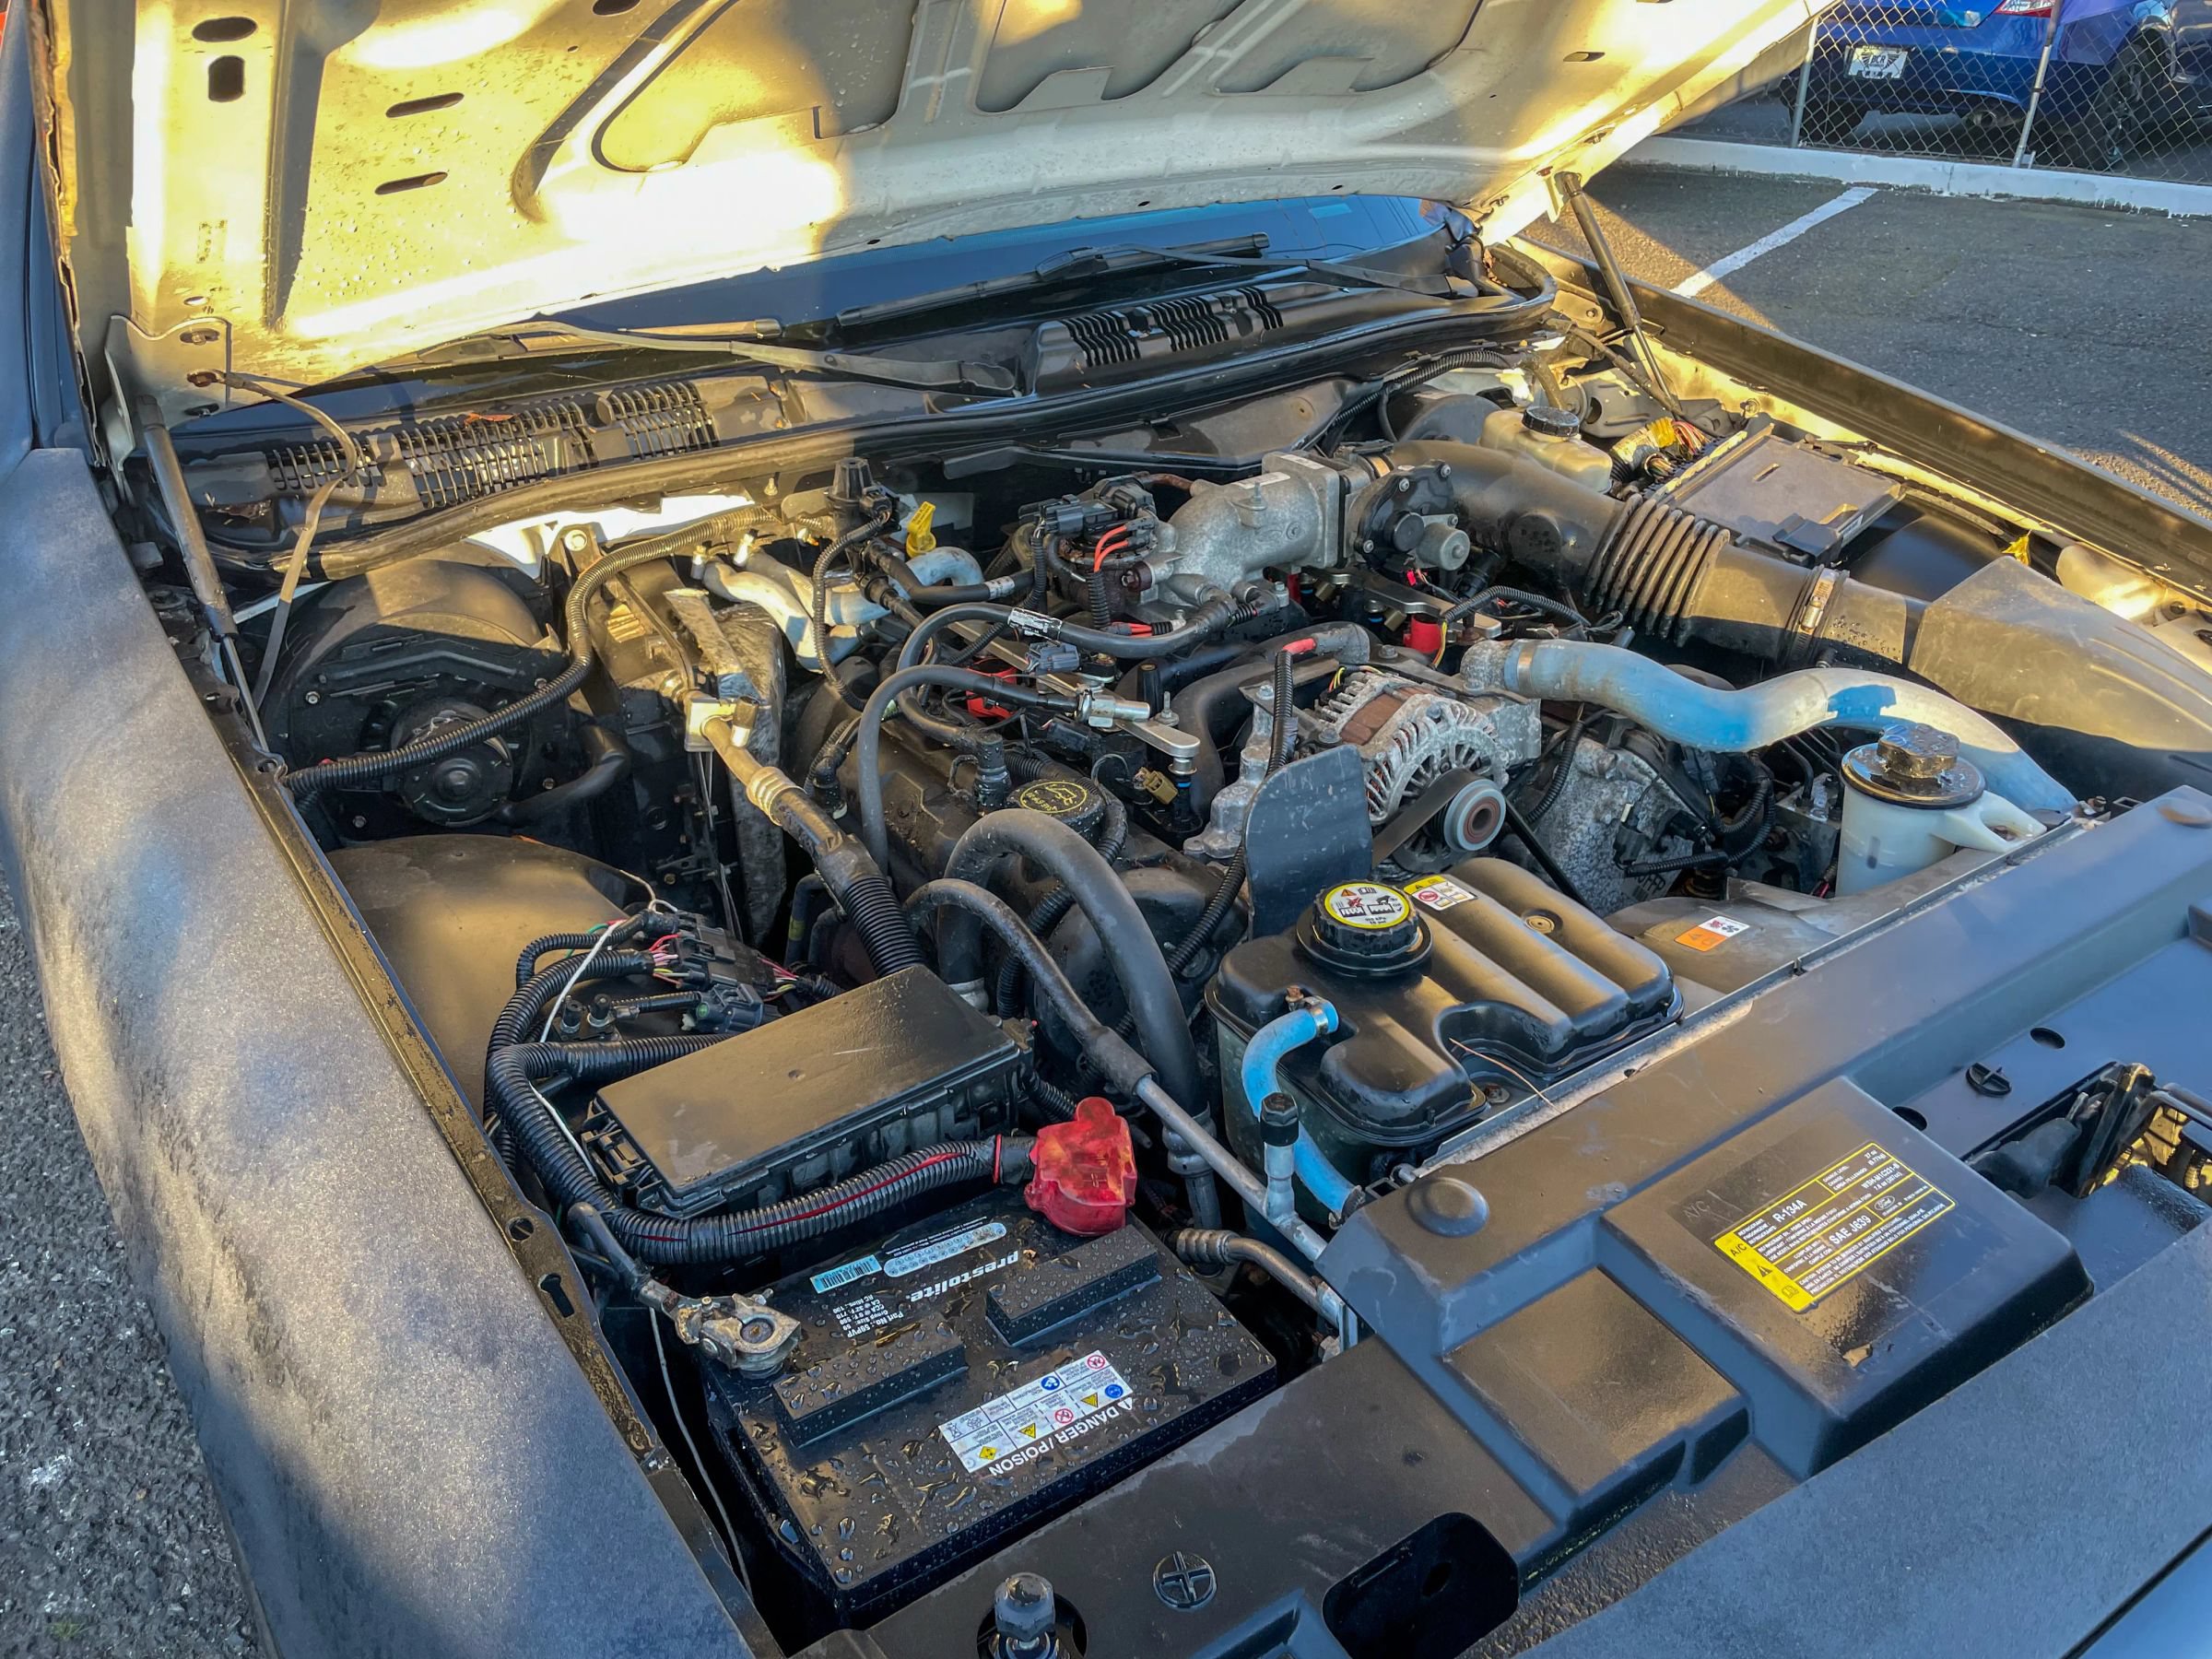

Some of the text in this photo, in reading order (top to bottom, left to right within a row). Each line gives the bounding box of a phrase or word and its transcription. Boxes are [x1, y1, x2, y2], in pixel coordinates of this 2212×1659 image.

[1772, 1200, 1806, 1222] R-134A
[1830, 1216, 1871, 1244] SAE J639
[1730, 1243, 1747, 1256] A/C
[910, 1251, 1018, 1302] prestolite
[870, 1310, 888, 1320] Group
[871, 1303, 885, 1312] CCA
[888, 1311, 903, 1322] Part
[1054, 1406, 1119, 1443] DANGER
[988, 1441, 1047, 1476] POISON
